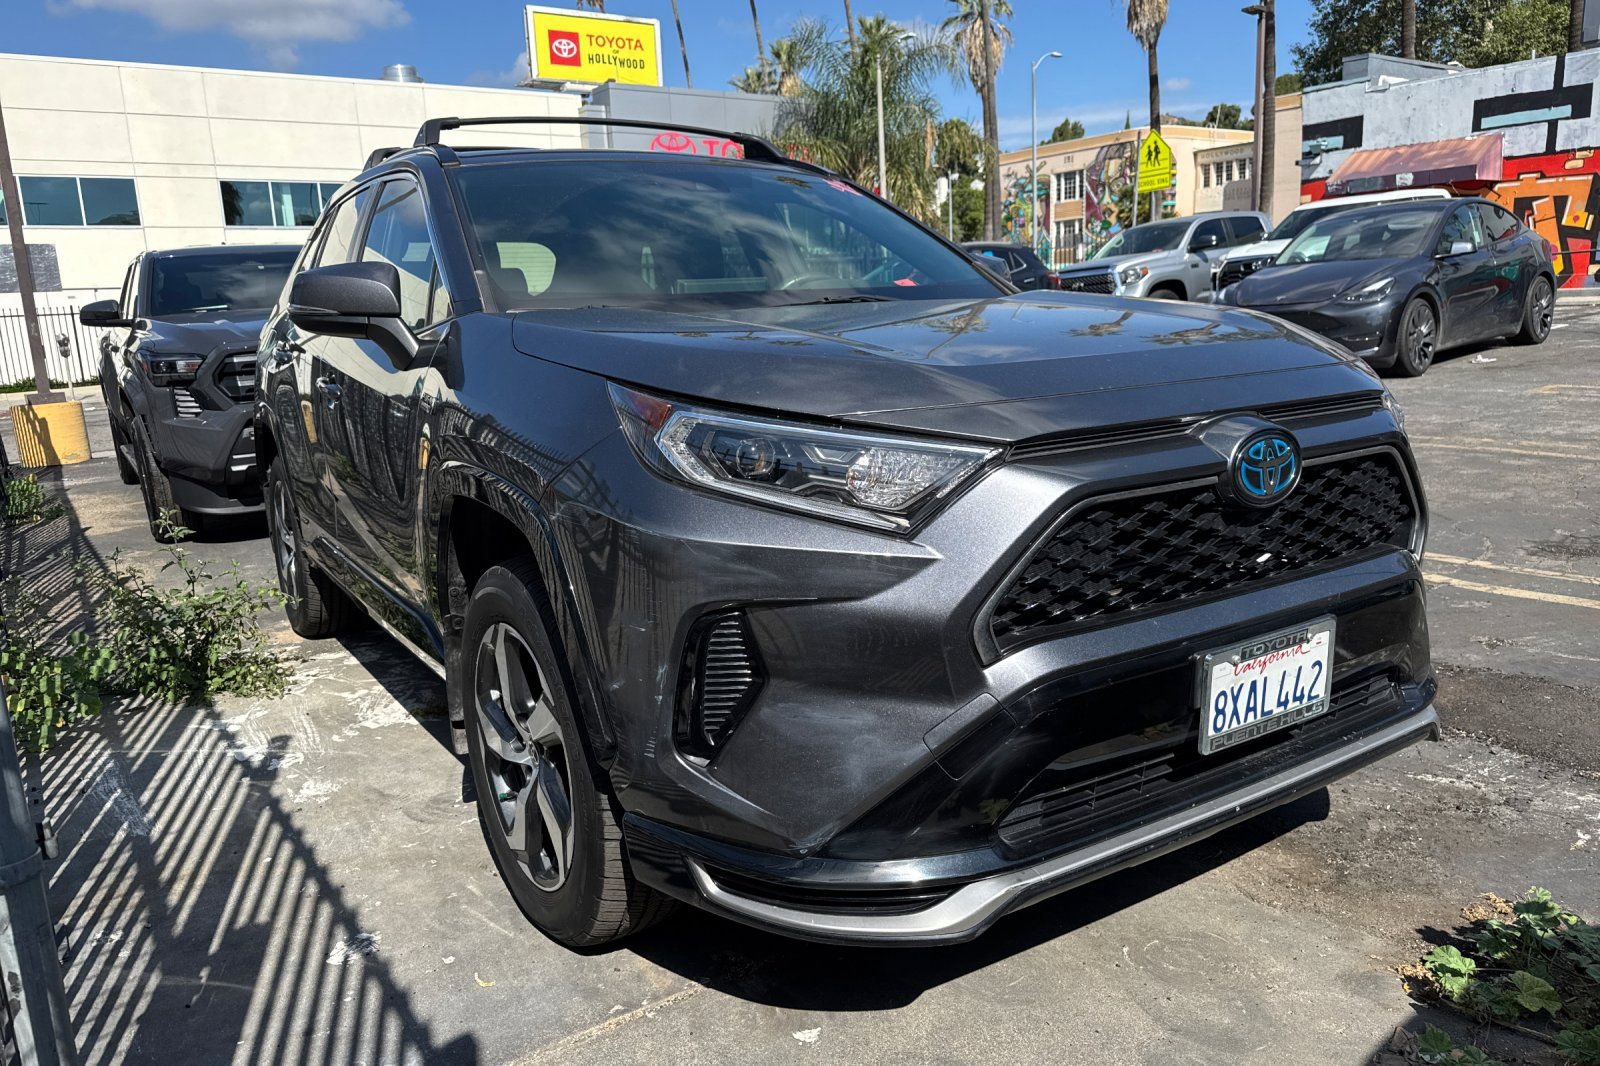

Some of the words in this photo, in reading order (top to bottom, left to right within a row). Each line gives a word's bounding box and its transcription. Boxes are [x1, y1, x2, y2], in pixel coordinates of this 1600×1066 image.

[586, 34, 644, 51] TOYOTA
[588, 53, 645, 69] HOLLYWOOD
[1233, 643, 1310, 677] California
[1242, 631, 1307, 659] TOYOTA
[1212, 660, 1323, 734] 8XAL442
[1211, 719, 1278, 751] PUENTE
[1281, 702, 1324, 726] HILLS
